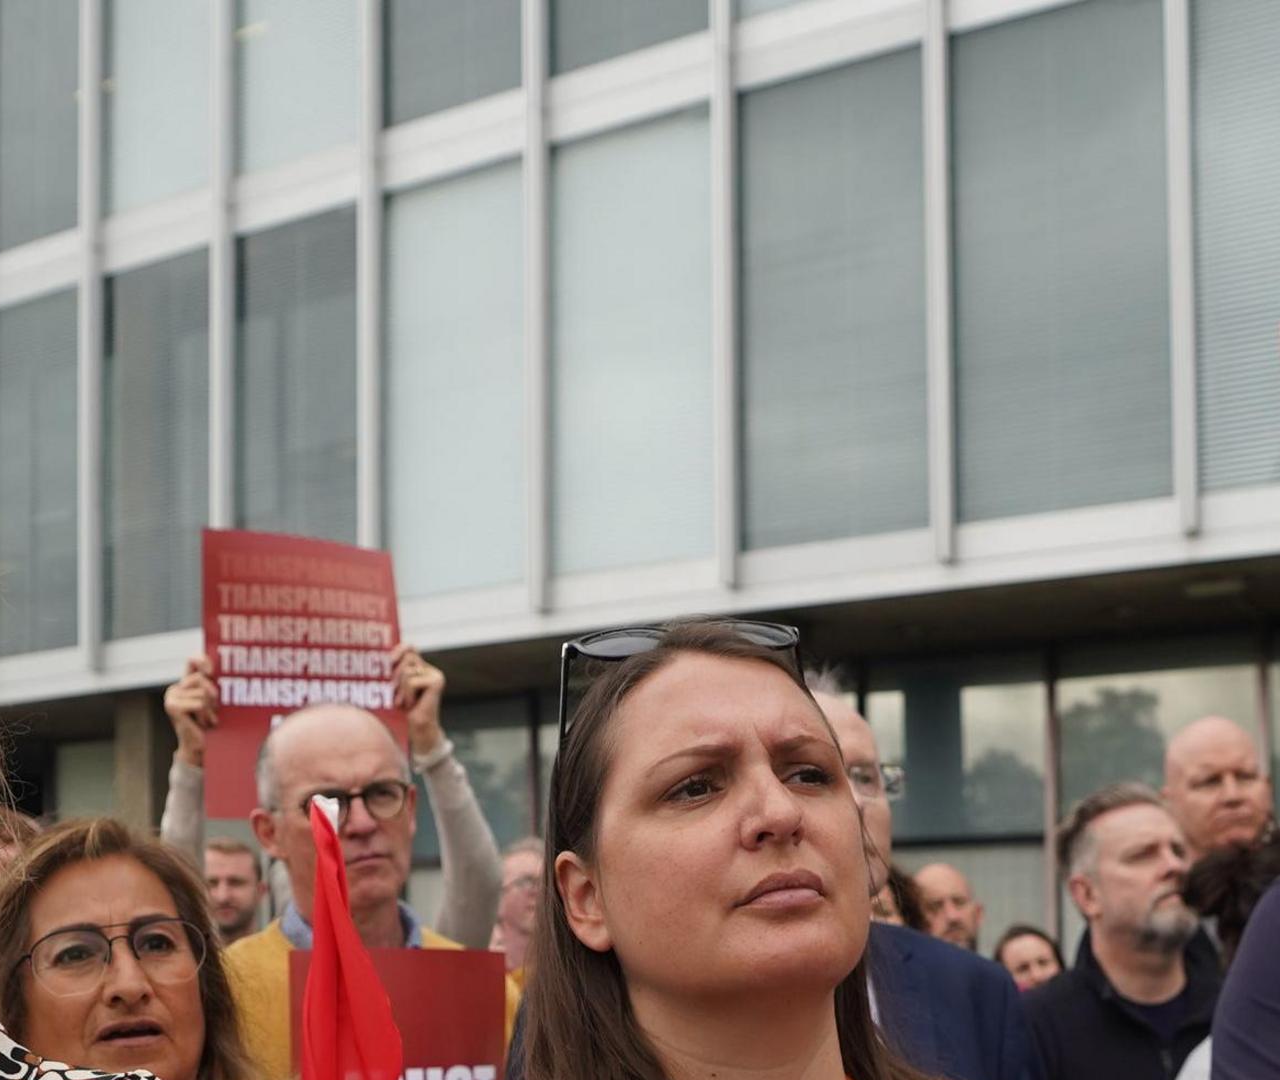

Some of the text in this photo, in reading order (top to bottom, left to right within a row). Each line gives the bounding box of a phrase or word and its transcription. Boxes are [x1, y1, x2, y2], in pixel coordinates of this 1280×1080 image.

[217, 583, 389, 620] TRANSPARENCY
[217, 613, 392, 647] TRANSPARENCY
[217, 644, 393, 677] TRANSPARENCY
[217, 675, 394, 710] TRANSPARENCY
